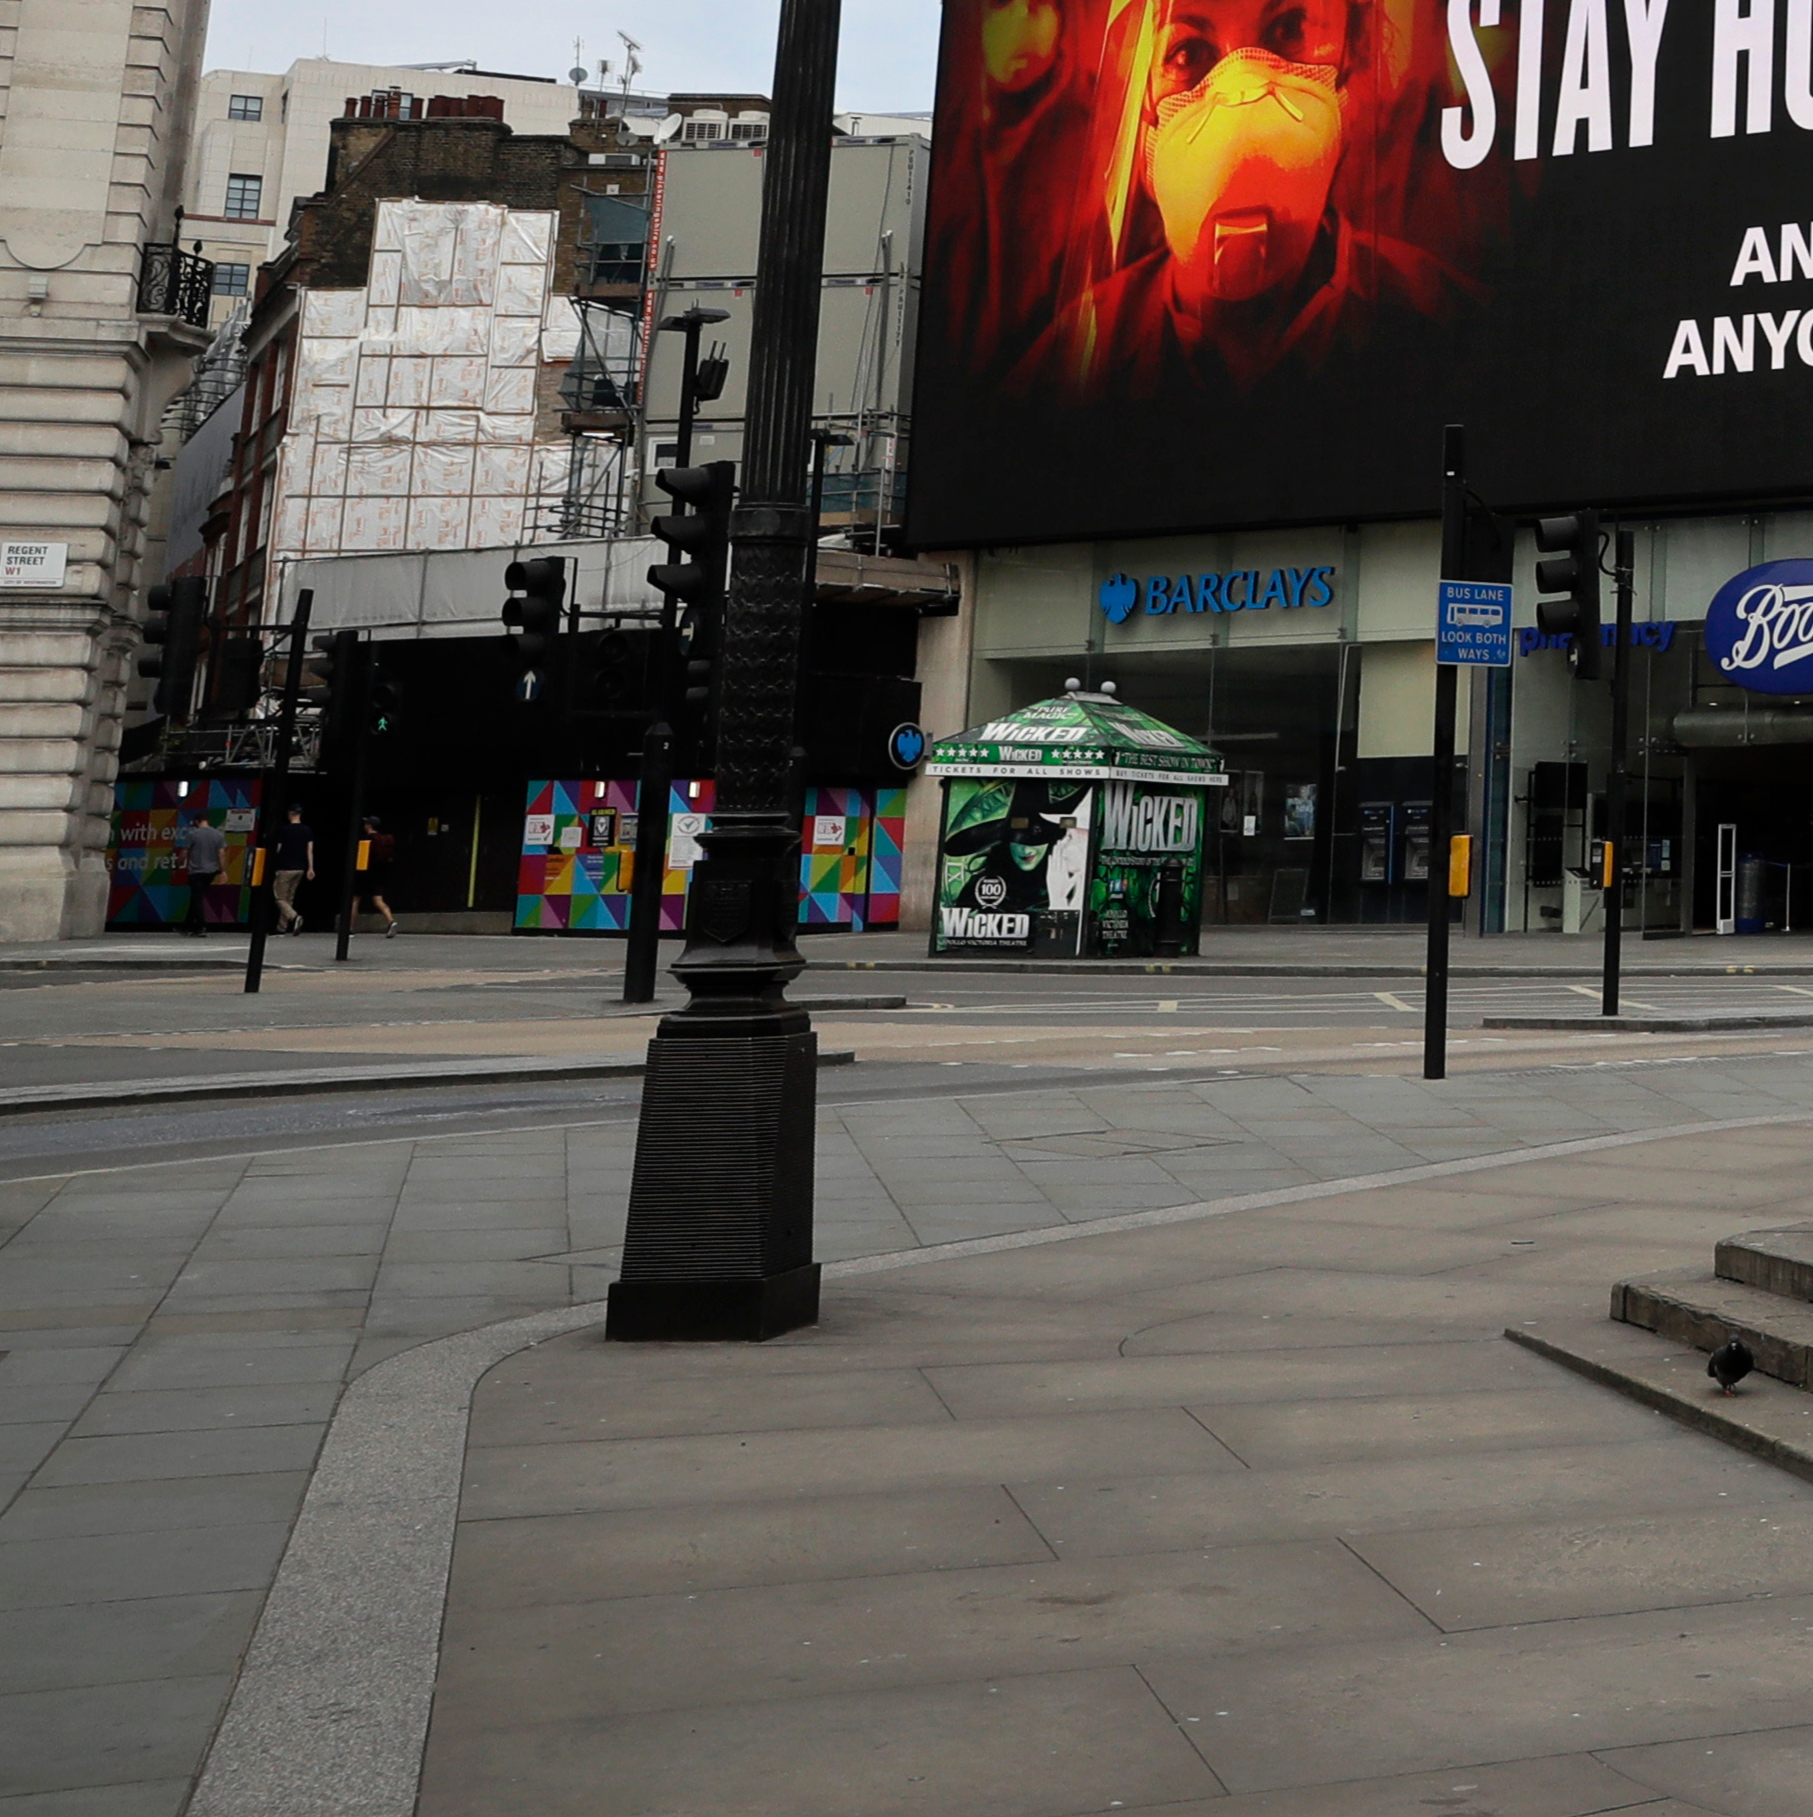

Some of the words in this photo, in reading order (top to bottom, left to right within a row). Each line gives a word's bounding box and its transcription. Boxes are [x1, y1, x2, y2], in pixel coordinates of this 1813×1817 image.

[7, 545, 49, 555] REGENT
[6, 556, 45, 565] STREET
[5, 567, 21, 575] W1
[1145, 566, 1336, 615] BARCLAYS
[1446, 586, 1471, 600] BUS
[1474, 587, 1504, 601] LANE
[1441, 631, 1472, 644] LOOK
[1475, 632, 1507, 645] BOTH
[1458, 648, 1490, 660] WAYS
[998, 745, 1042, 762] WICKED
[933, 766, 982, 774] TICKETS
[993, 767, 1015, 775] FOR
[1059, 768, 1100, 776] SHOWS
[1101, 781, 1198, 853] WICKED
[121, 822, 157, 841] with
[118, 855, 148, 870] and
[980, 883, 1002, 896] 100
[940, 906, 1030, 939] WICKED
